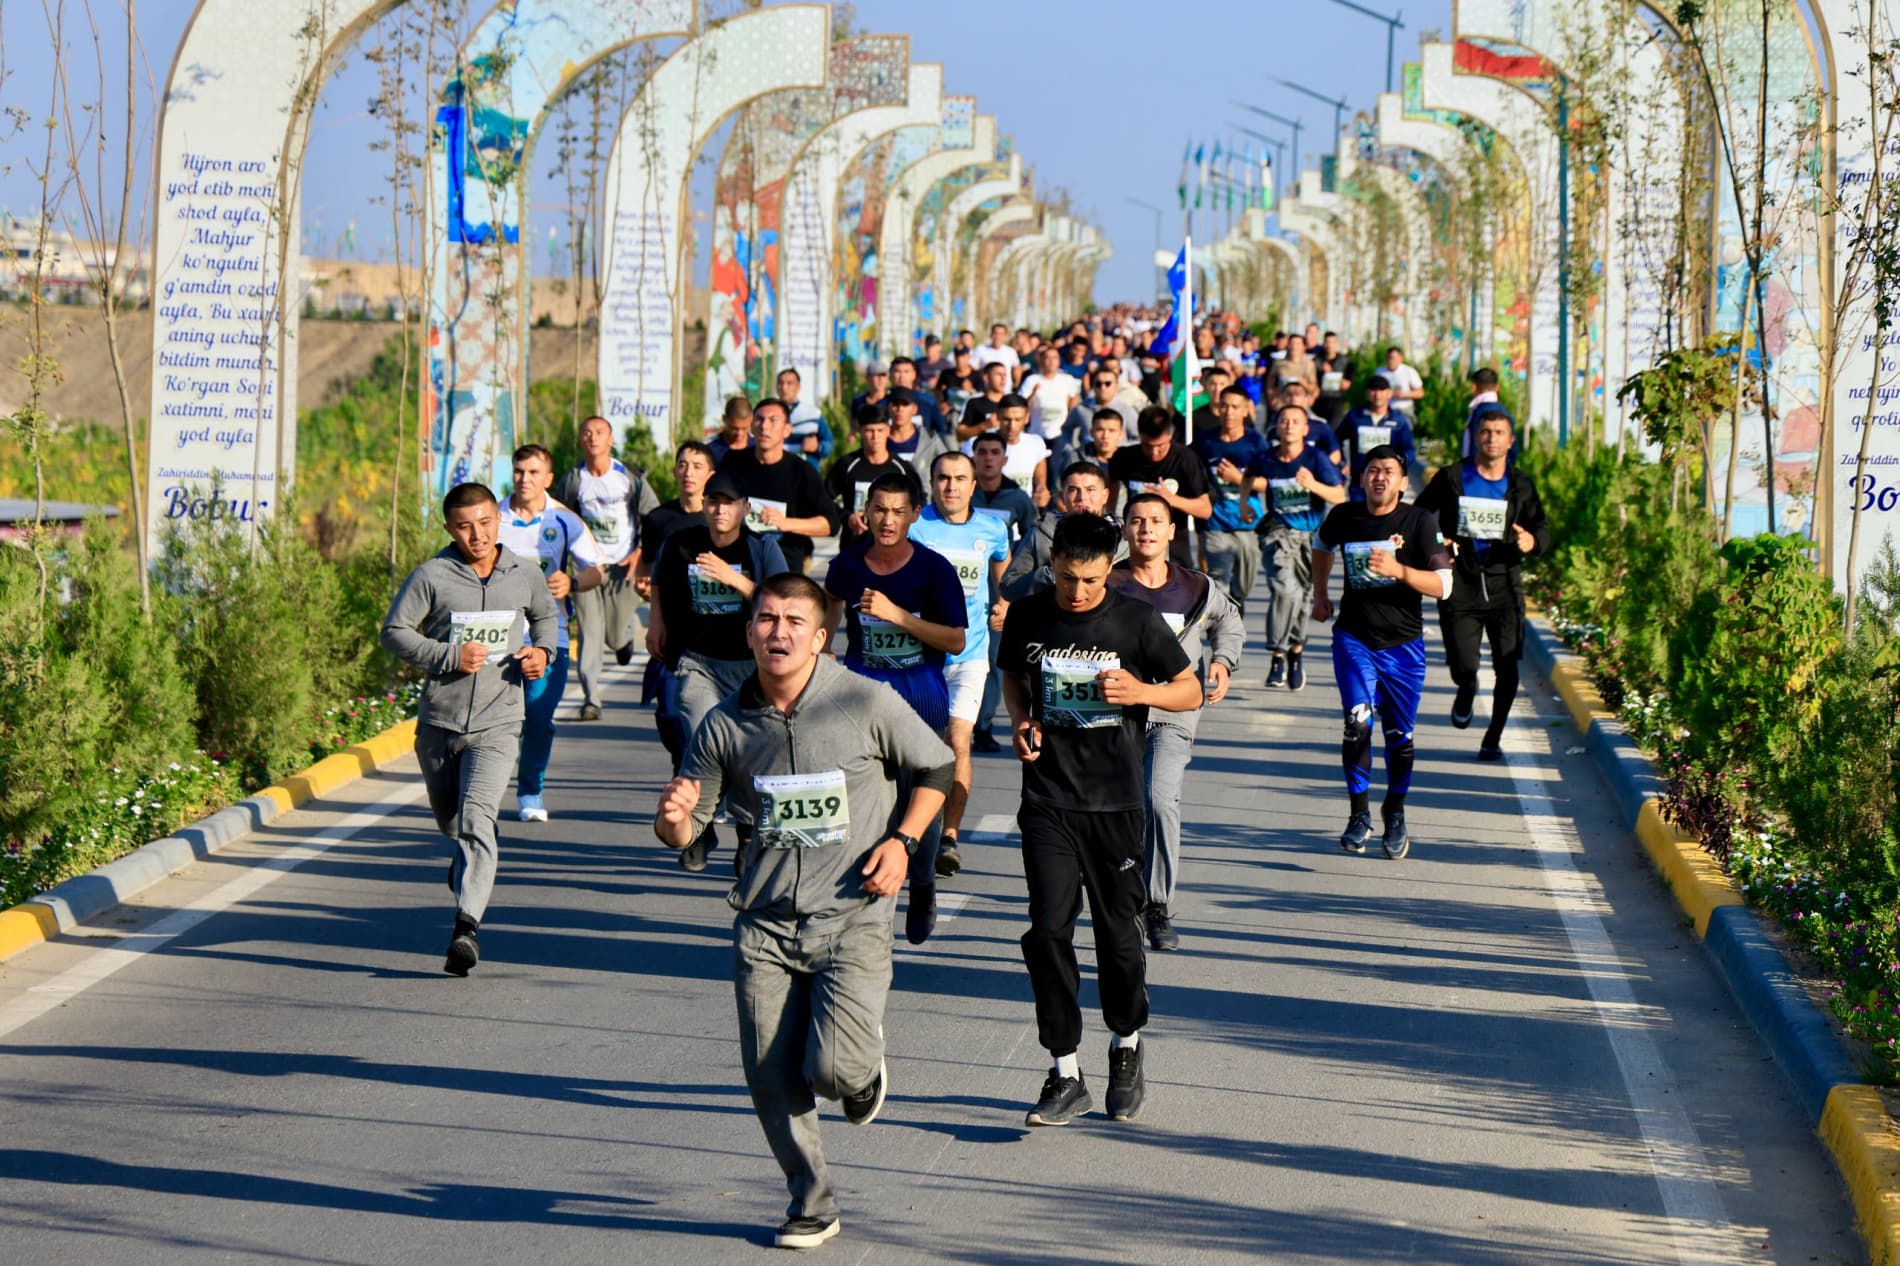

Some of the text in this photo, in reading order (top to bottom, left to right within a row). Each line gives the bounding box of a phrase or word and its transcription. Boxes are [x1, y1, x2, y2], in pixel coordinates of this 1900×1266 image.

[238, 161, 266, 173] aro
[166, 180, 199, 201] yod
[178, 203, 217, 220] shod
[210, 303, 232, 320] Bu
[168, 328, 216, 350] aning
[177, 426, 211, 449] yod
[1470, 511, 1503, 524] 3655
[778, 796, 841, 820] 3139
